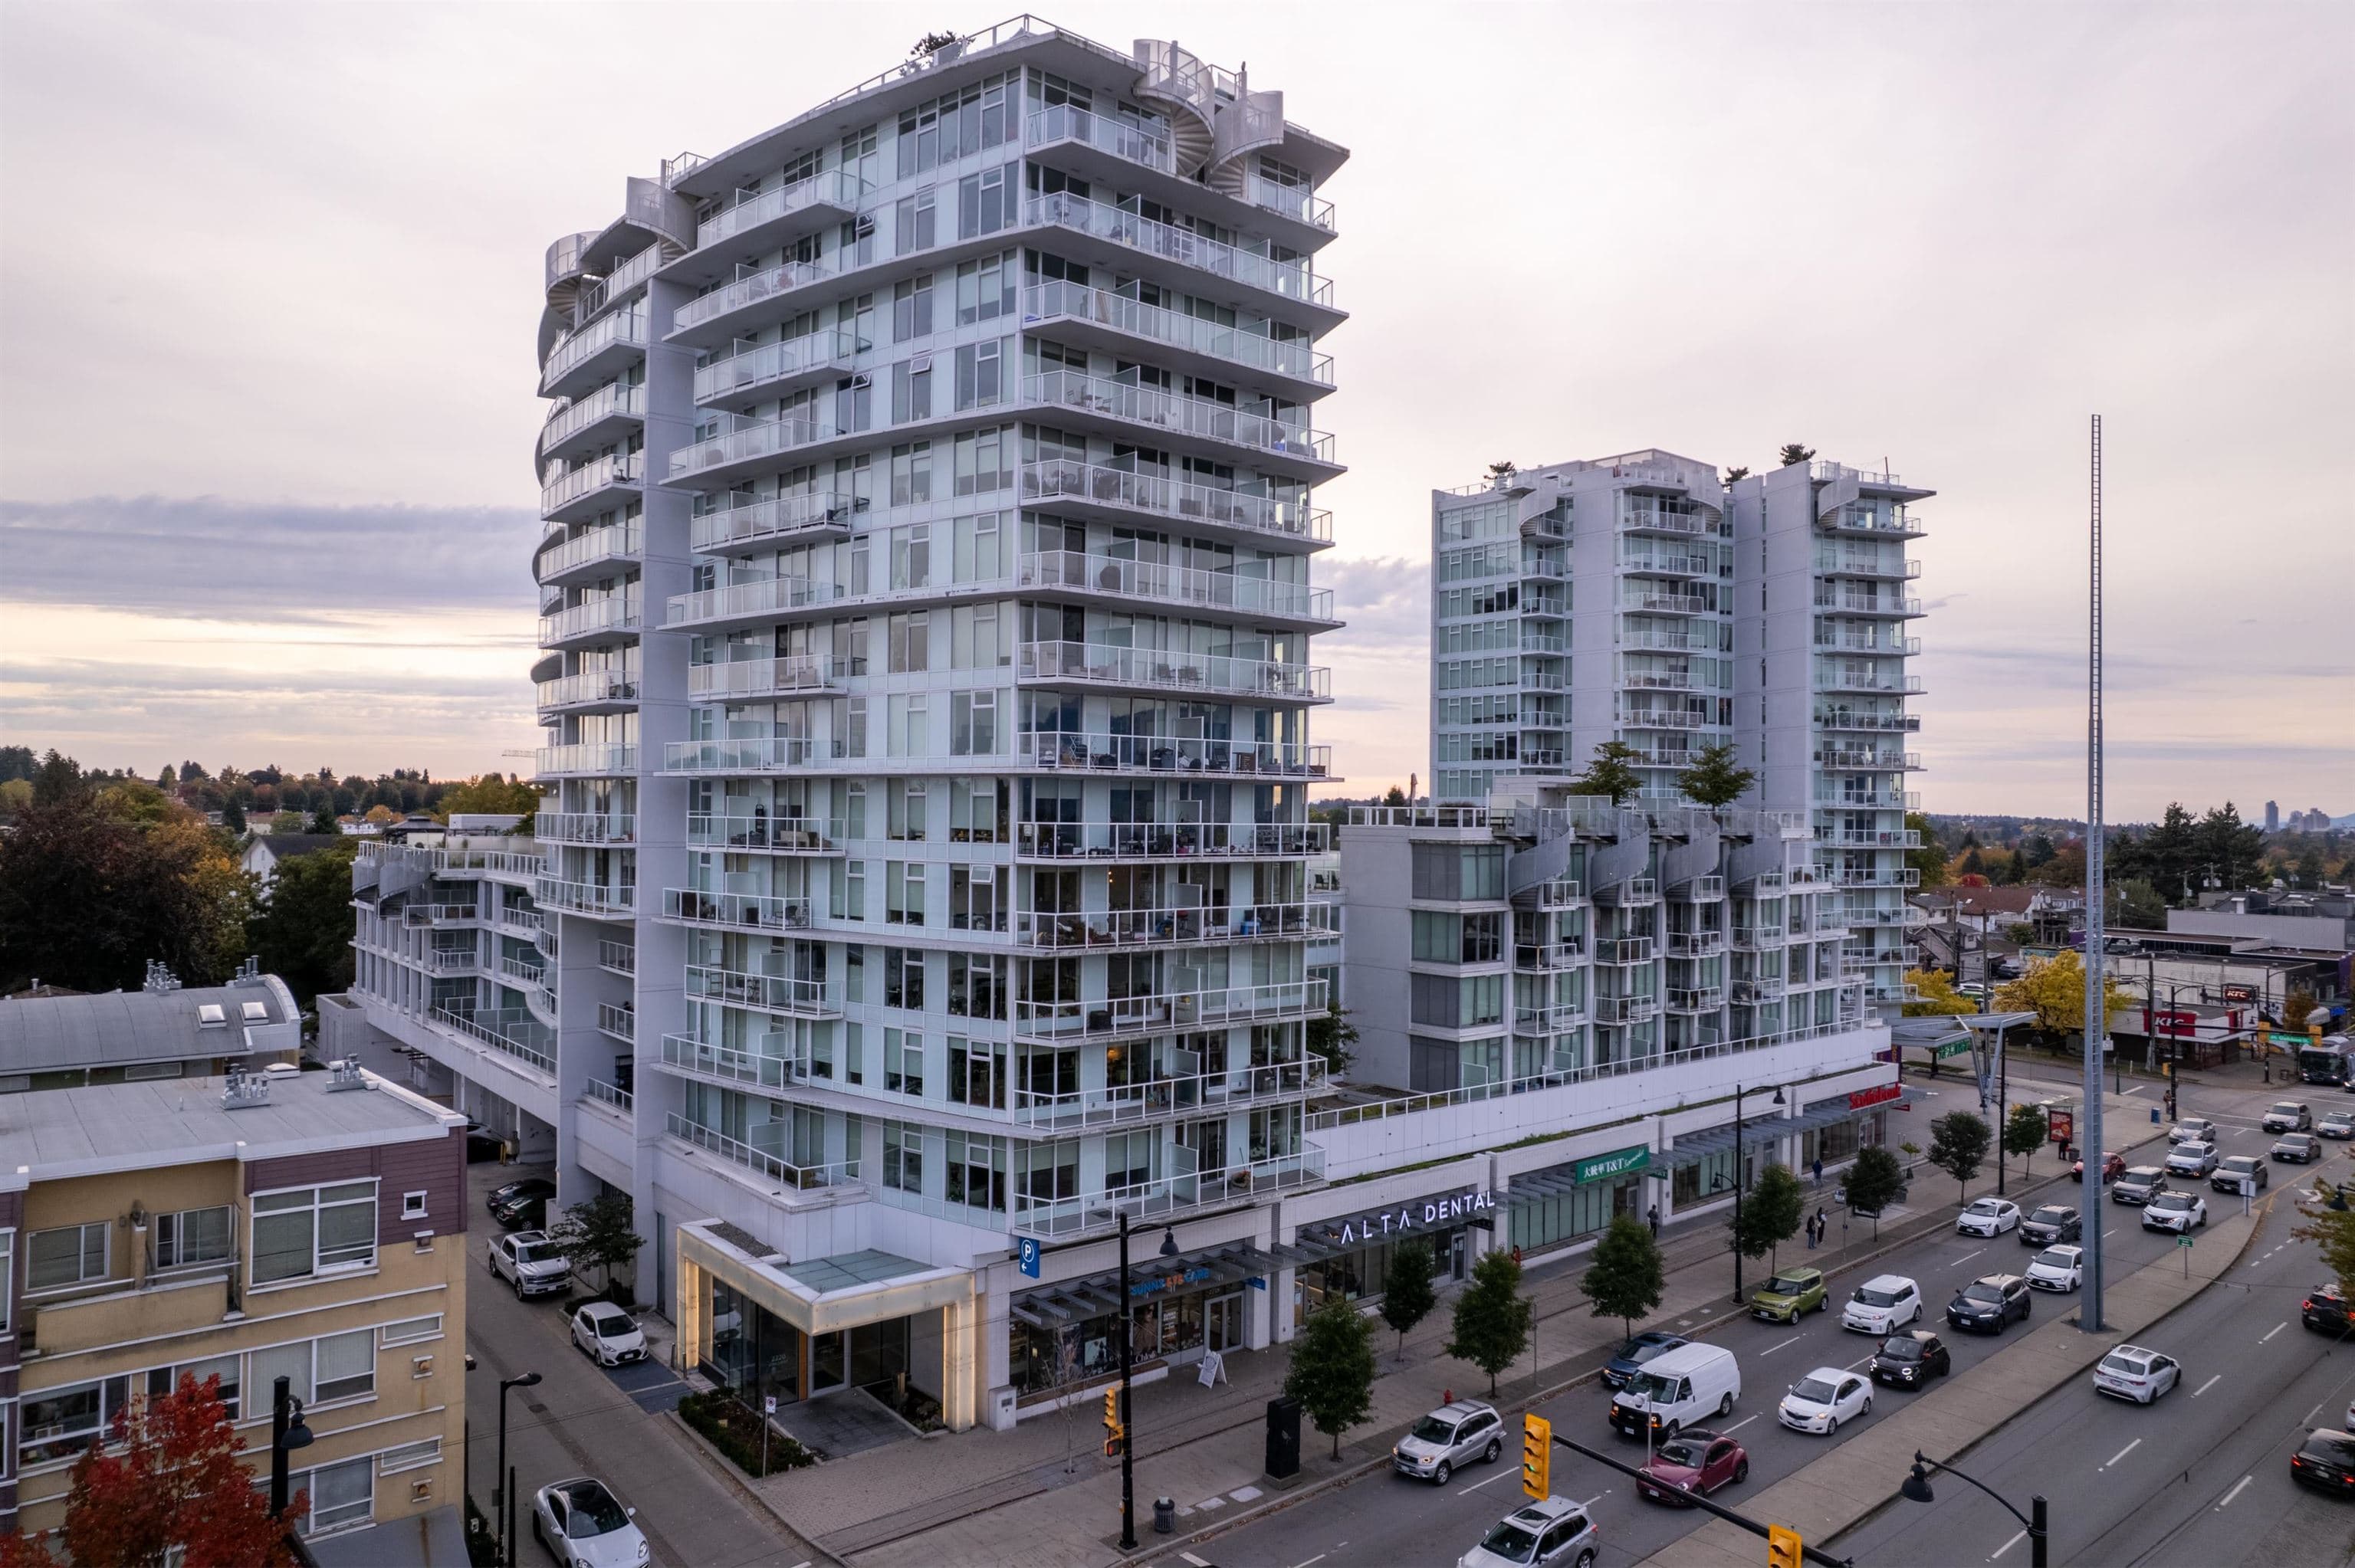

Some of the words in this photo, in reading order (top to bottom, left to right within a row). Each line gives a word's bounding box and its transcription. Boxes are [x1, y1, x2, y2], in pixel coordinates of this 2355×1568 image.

[1849, 1081, 1901, 1109] Scotiabank
[1606, 1157, 1624, 1173] T&T
[1341, 1209, 1411, 1245] ALTA
[1425, 1190, 1495, 1223] DENTAL
